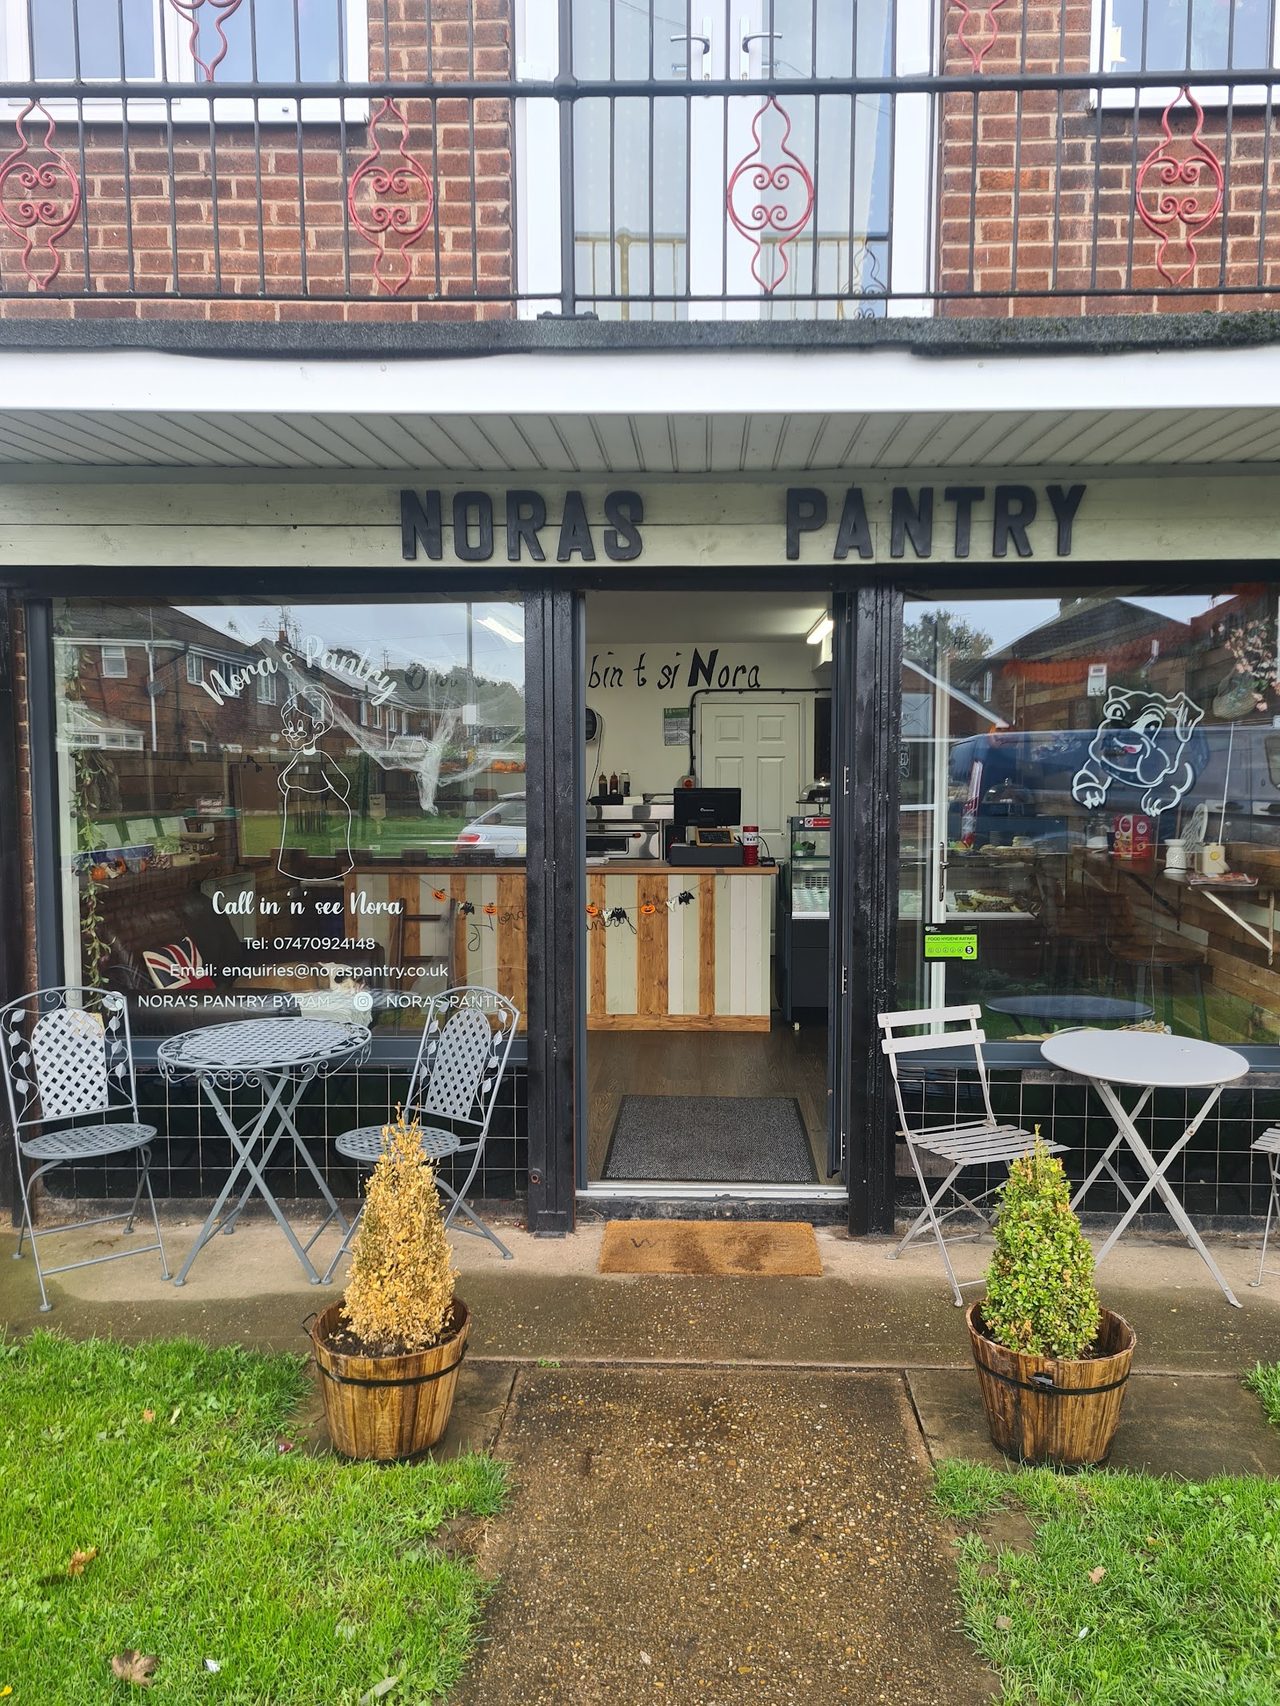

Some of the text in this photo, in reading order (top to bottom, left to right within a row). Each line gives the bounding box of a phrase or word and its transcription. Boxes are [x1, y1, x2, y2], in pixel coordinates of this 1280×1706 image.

[400, 484, 1087, 562] NORAS PANTRY
[299, 634, 398, 707] Pantry
[588, 647, 761, 690] bin t si Nora
[212, 890, 255, 915] Call
[259, 896, 281, 915] in
[314, 900, 344, 915] see
[350, 890, 404, 915] Nora
[243, 937, 376, 950] Tel: 07470924148
[169, 964, 449, 979] Email: enquiries@noraspantry.co.uk
[138, 995, 330, 1008] NORA'S PANTRY BYRAM
